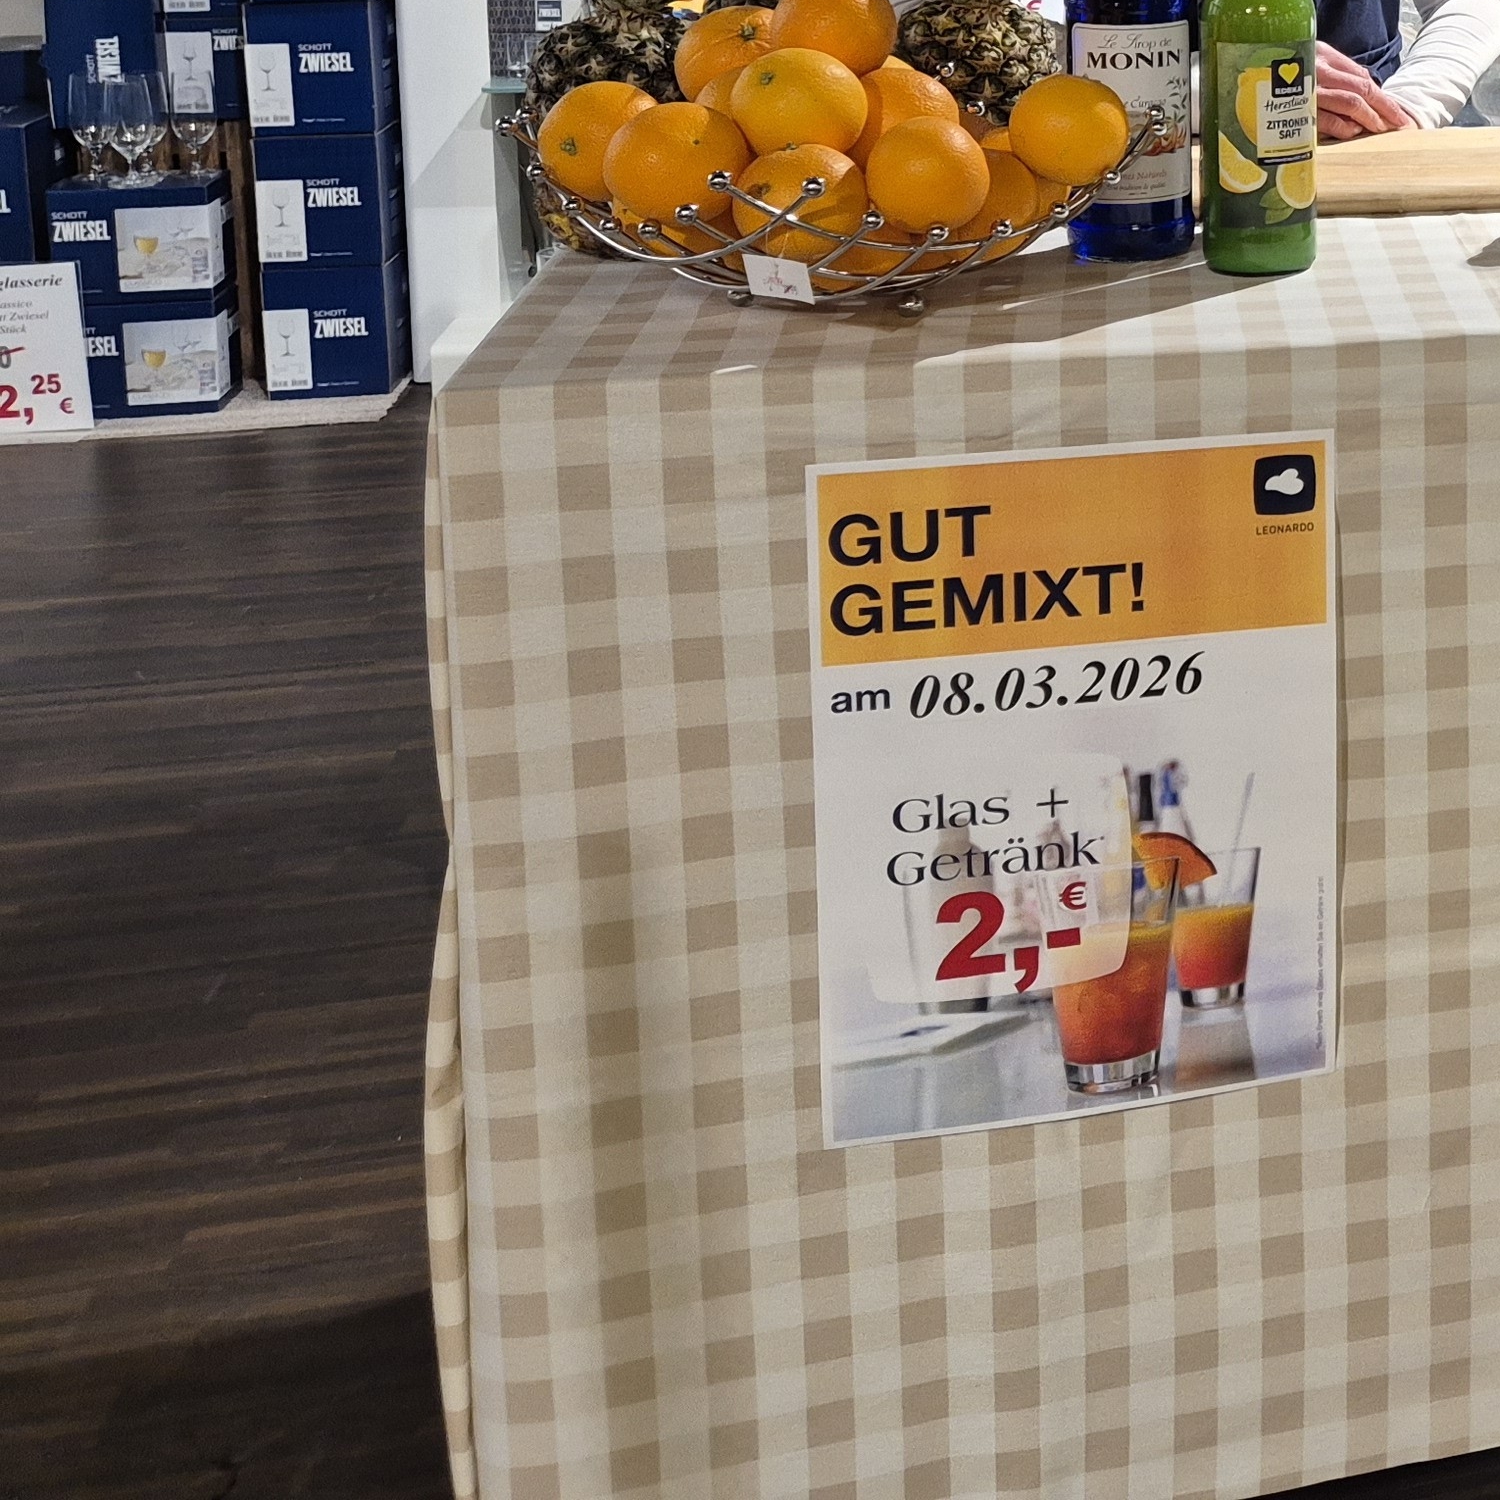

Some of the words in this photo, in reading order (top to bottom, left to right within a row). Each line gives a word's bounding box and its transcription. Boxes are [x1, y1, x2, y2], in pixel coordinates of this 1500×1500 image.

[213, 35, 245, 51] ZWIES
[1097, 33, 1118, 49] Le
[1127, 32, 1157, 51] Sirop
[1159, 37, 1172, 48] de
[299, 52, 354, 73] ZWIESEL
[1087, 49, 1181, 71] MONIN
[1266, 115, 1309, 132] ZITRONEN
[1278, 128, 1302, 140] SAFT
[307, 186, 362, 208] ZWIESEL
[52, 220, 111, 243] ZWIESEL
[314, 317, 369, 339] ZWIESEL
[827, 505, 992, 567] GUT
[1255, 522, 1315, 536] LEONARDO
[828, 561, 1146, 638] GEMIXT!
[829, 686, 892, 715] am
[909, 650, 1206, 720] 08.03.2026
[892, 793, 1011, 834] Glas
[886, 831, 1105, 887] Getränk
[1058, 881, 1087, 911] €
